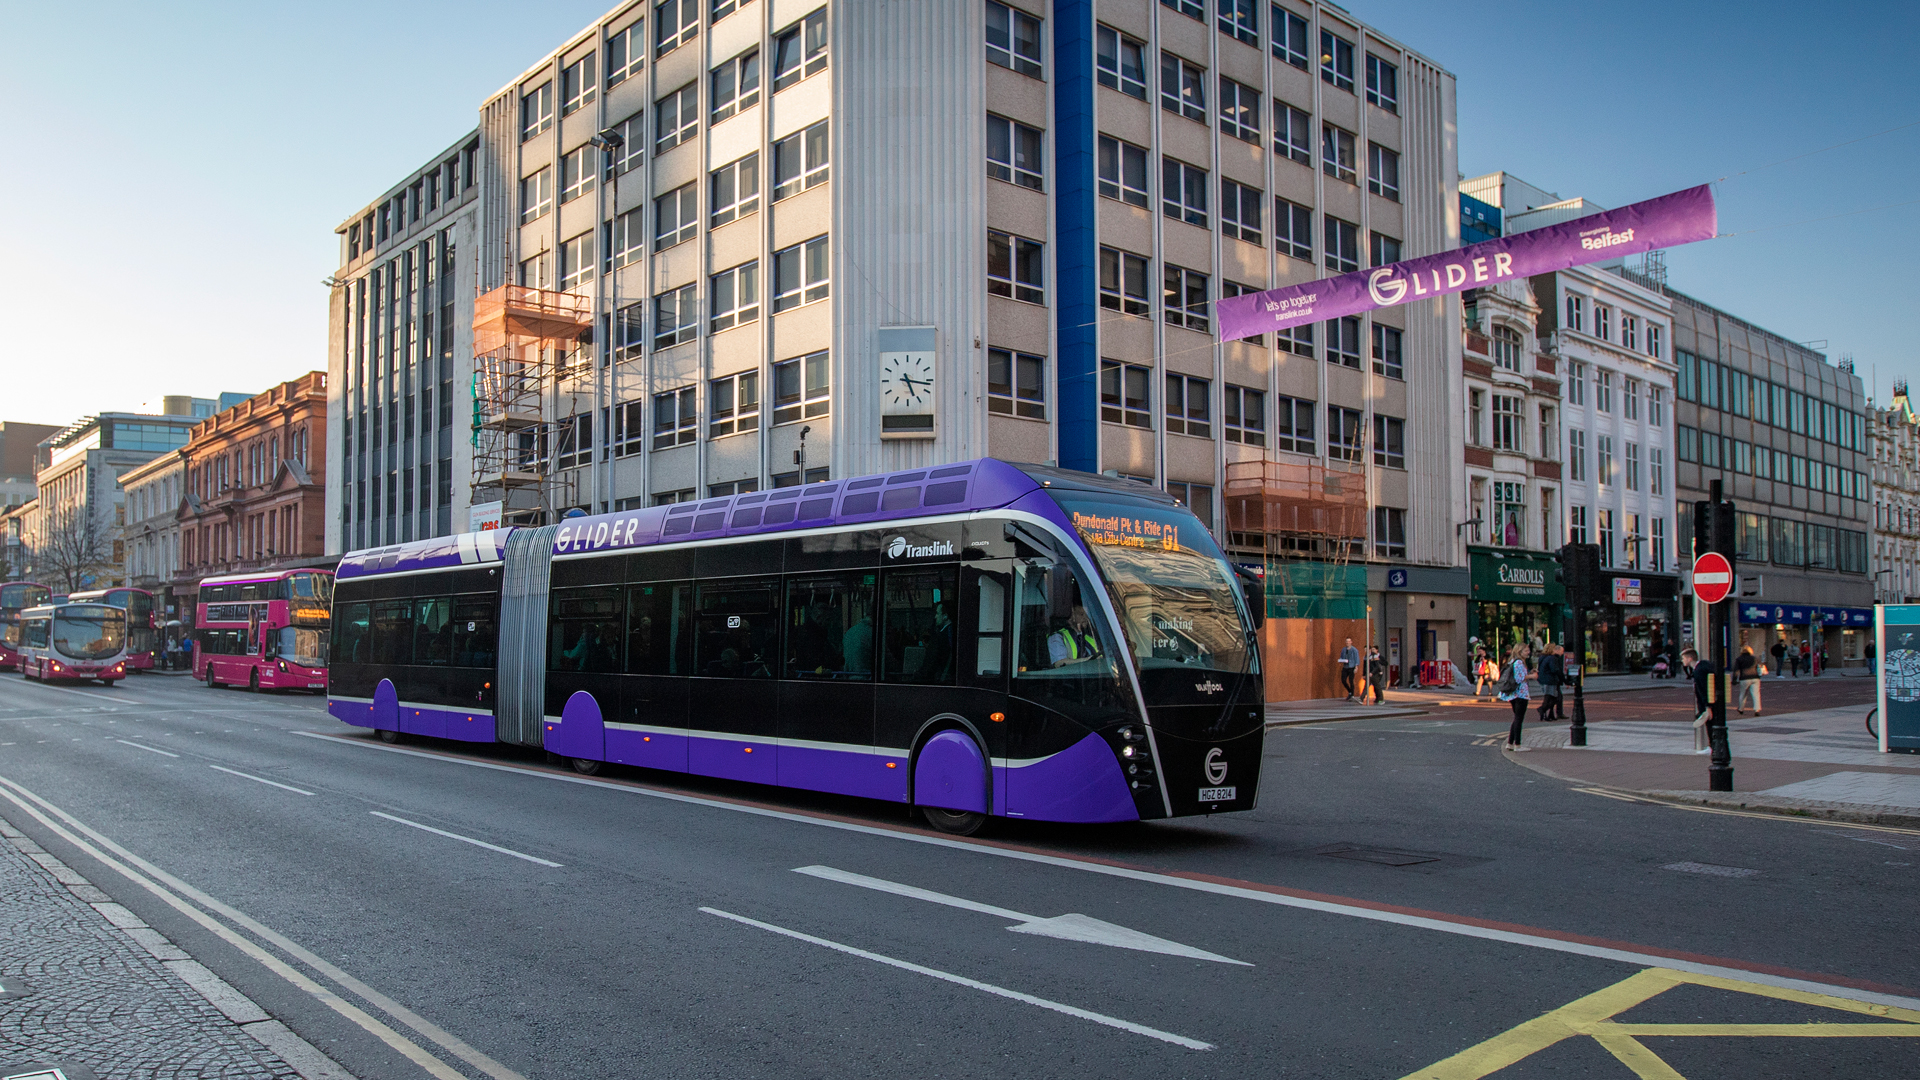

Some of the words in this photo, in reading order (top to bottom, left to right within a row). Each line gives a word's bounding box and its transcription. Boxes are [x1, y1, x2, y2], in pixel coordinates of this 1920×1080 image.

[1581, 228, 1635, 250] Belfast
[1368, 252, 1513, 306] GLIDER
[1265, 301, 1280, 312] let's
[1280, 300, 1290, 311] go
[1290, 293, 1318, 308] together
[1275, 306, 1313, 321] translink.co.uk
[1073, 511, 1119, 532] Dundonald
[1120, 517, 1133, 533] Pk
[1134, 519, 1142, 534] &
[1143, 520, 1161, 536] Ride
[557, 517, 639, 551] GLIDER
[1091, 530, 1103, 544] via
[1104, 530, 1119, 545] City
[1120, 533, 1145, 548] Centre
[1163, 524, 1180, 551] G1
[905, 540, 954, 558] Translink
[1500, 563, 1544, 584] CARROLLS
[1158, 617, 1194, 632] making
[1202, 790, 1216, 800] HGZ
[1217, 789, 1232, 799] 8214
